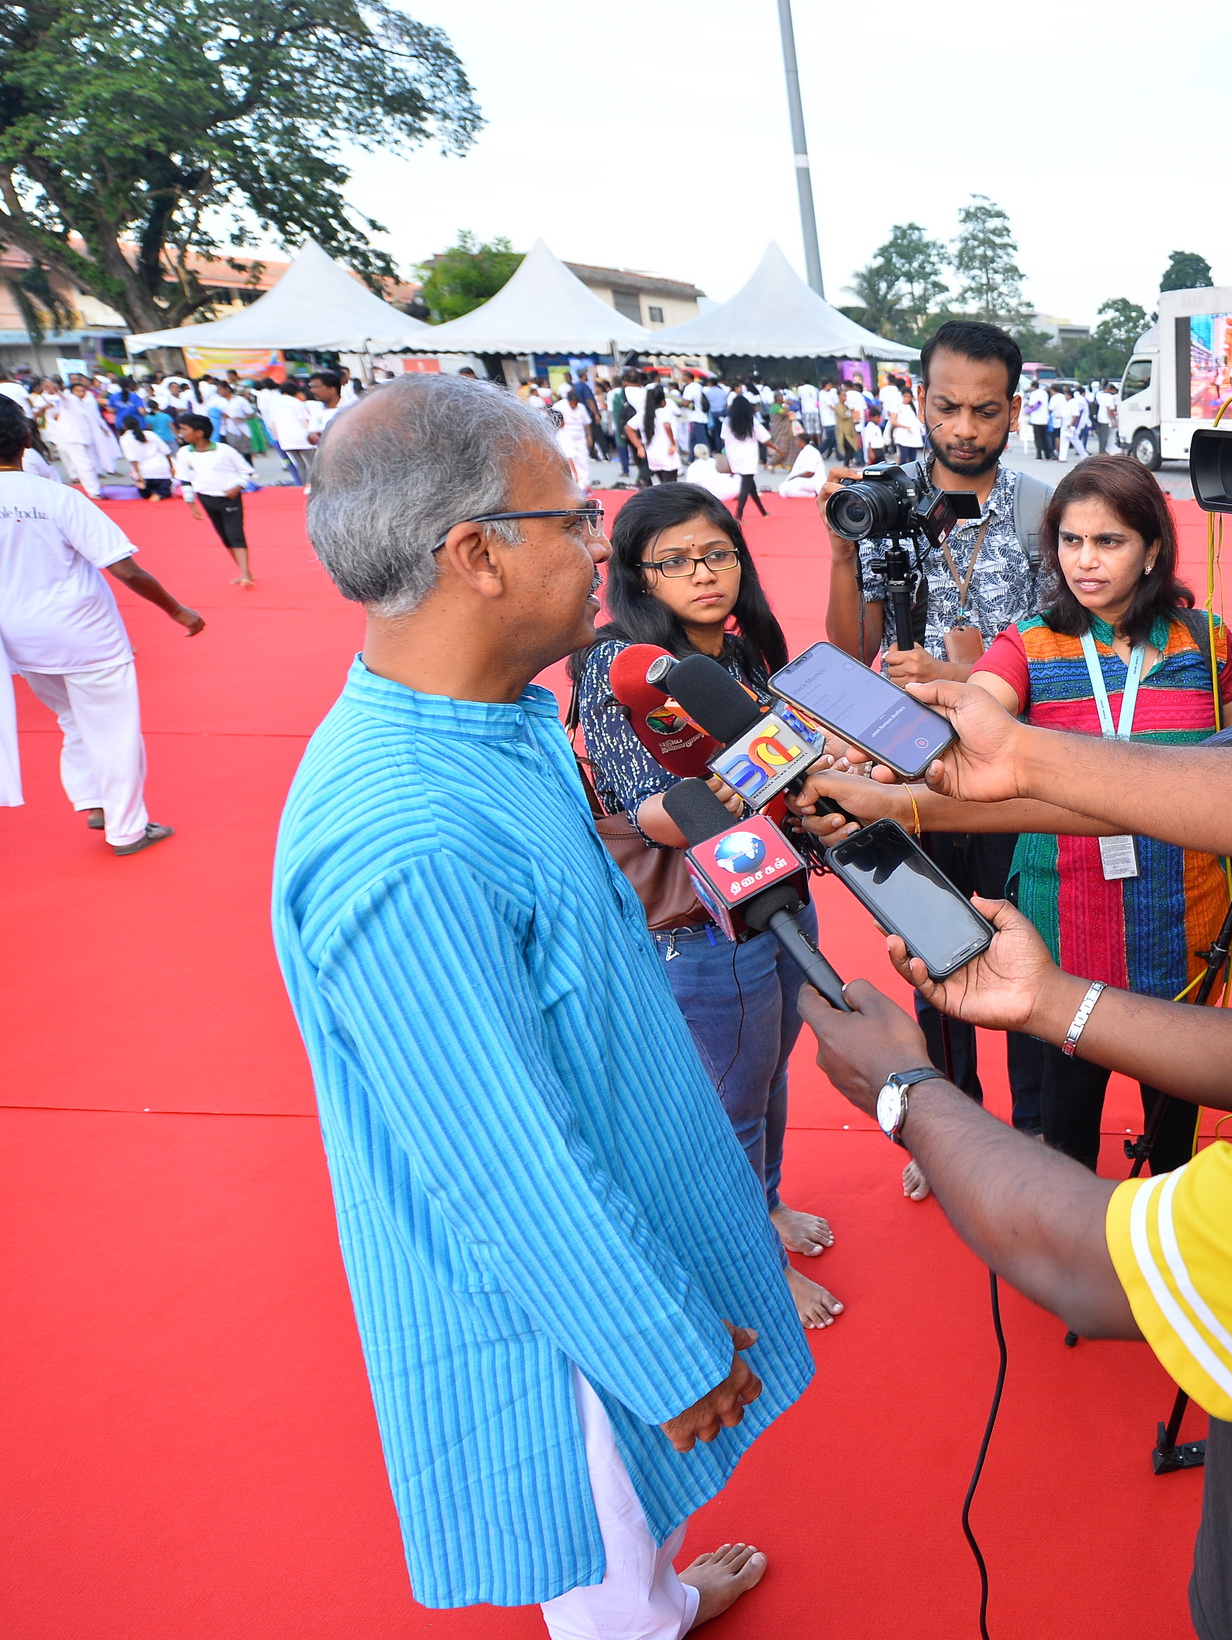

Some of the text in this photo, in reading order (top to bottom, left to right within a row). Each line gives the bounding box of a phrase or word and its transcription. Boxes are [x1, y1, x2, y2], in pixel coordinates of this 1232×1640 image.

[752, 752, 808, 799] BERNAMA NEWS CHANNEL
[730, 857, 788, 896] திசைகள்
